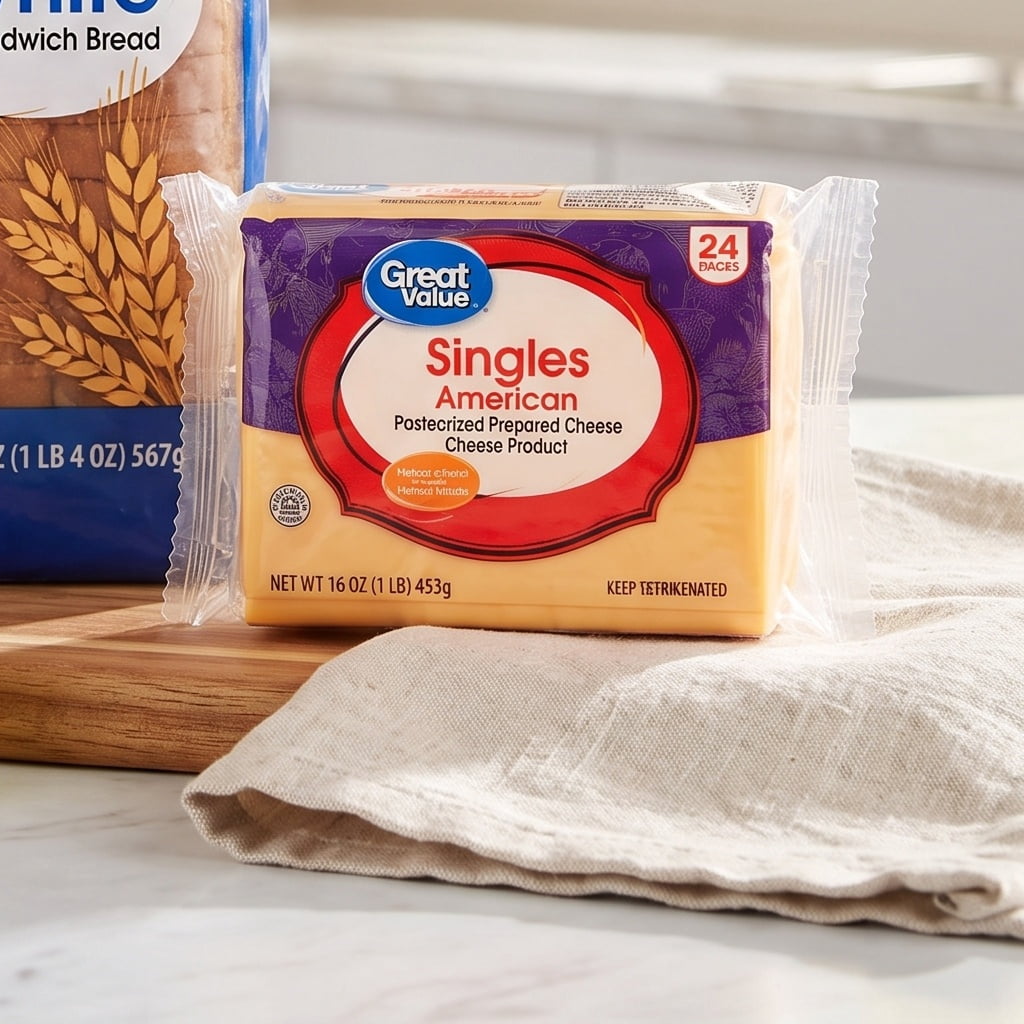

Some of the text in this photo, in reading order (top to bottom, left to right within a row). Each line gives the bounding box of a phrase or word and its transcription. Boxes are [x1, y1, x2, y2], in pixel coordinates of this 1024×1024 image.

[87, 26, 161, 51] Bread
[699, 234, 738, 259] 24
[380, 259, 470, 289] Great
[401, 287, 470, 308] Value
[426, 337, 590, 388] Singles
[435, 385, 578, 411] American
[489, 416, 560, 436] Prepared
[564, 418, 623, 434] Cheese
[10, 443, 29, 472] (1
[38, 444, 65, 468] LB
[70, 444, 84, 468] 4
[89, 443, 126, 472] OZ)
[131, 443, 183, 473] 567g
[445, 437, 568, 454] Cheese Product
[271, 574, 451, 599] NET WT 16 OZ (1 LB) 453g
[607, 581, 636, 595] KEEP
